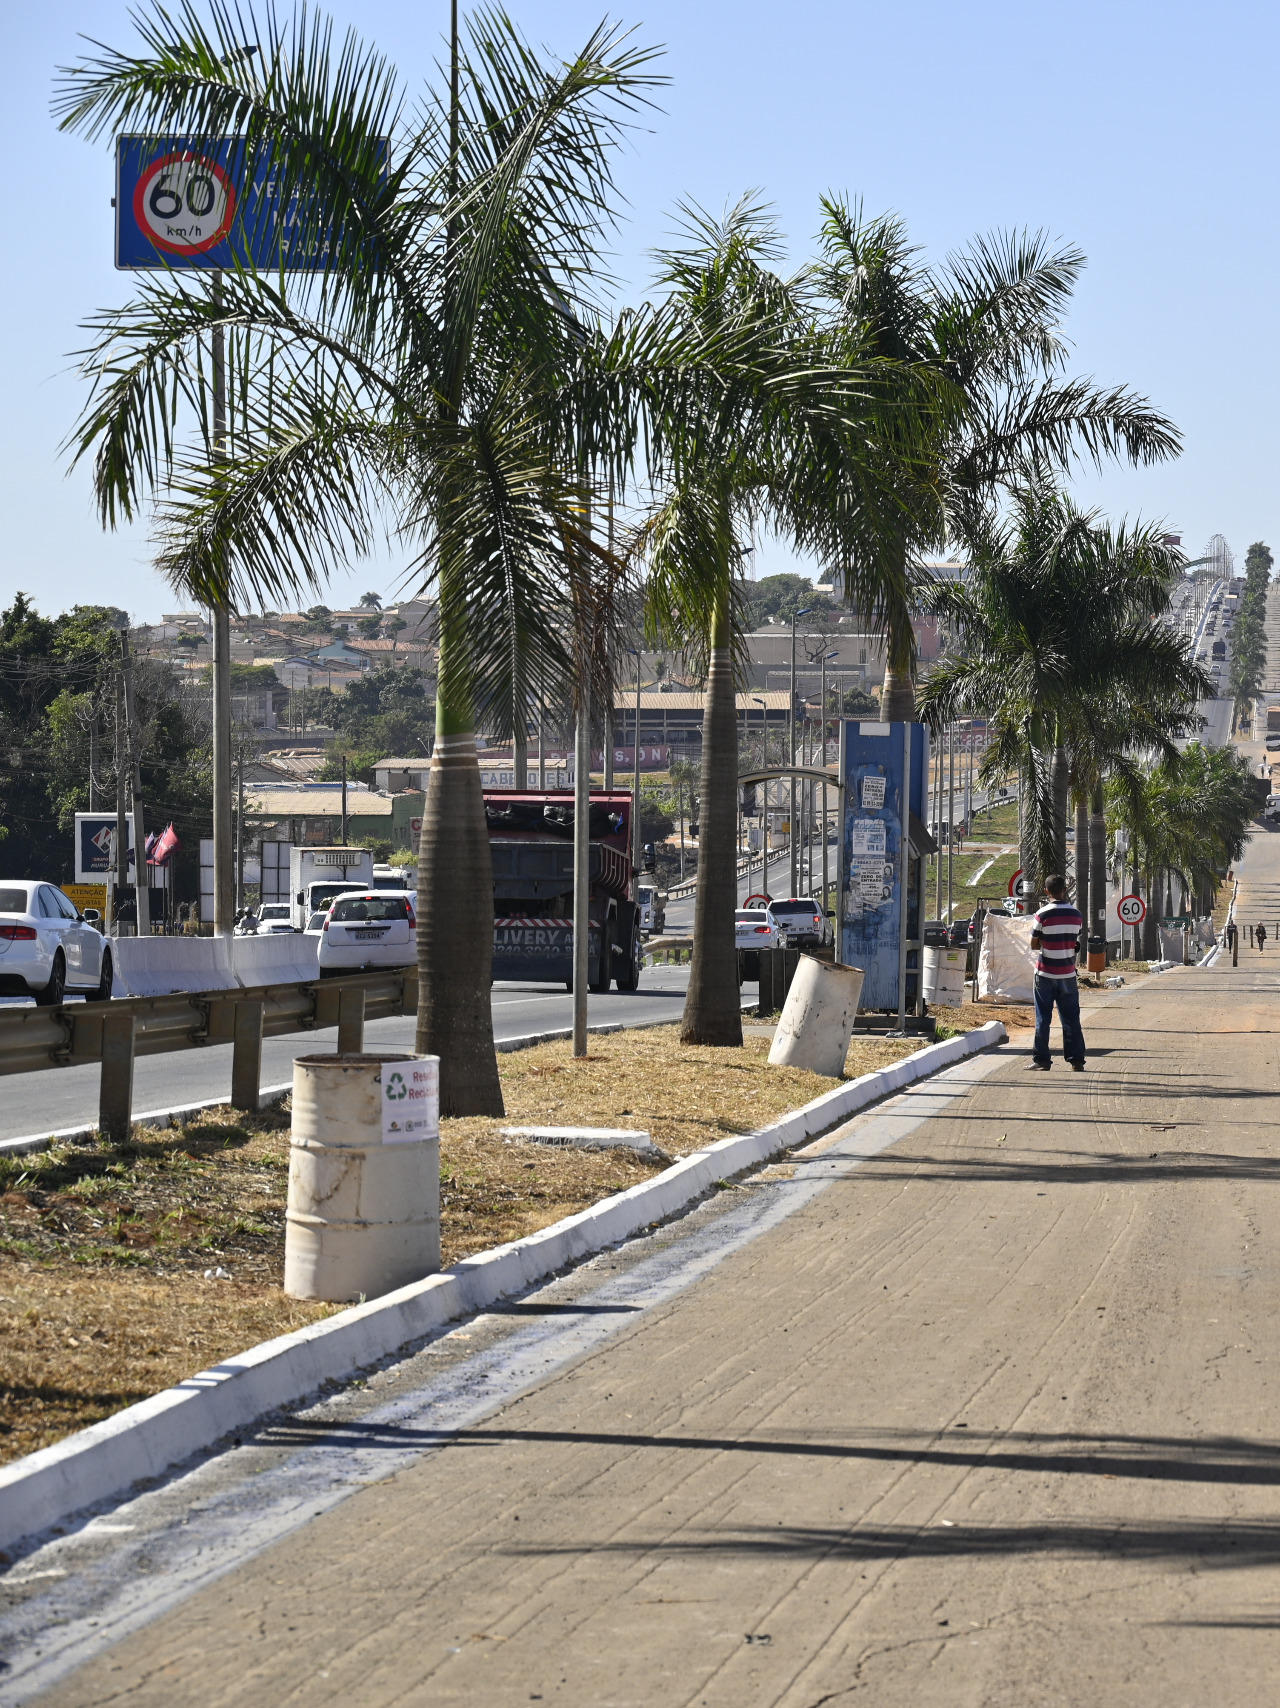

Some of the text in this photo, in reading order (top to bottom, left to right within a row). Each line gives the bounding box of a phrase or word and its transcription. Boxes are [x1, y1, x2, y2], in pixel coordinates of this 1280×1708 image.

[149, 174, 215, 219] 60
[167, 225, 202, 237] km/h
[1121, 902, 1140, 915] 60
[494, 929, 559, 945] LIVERY
